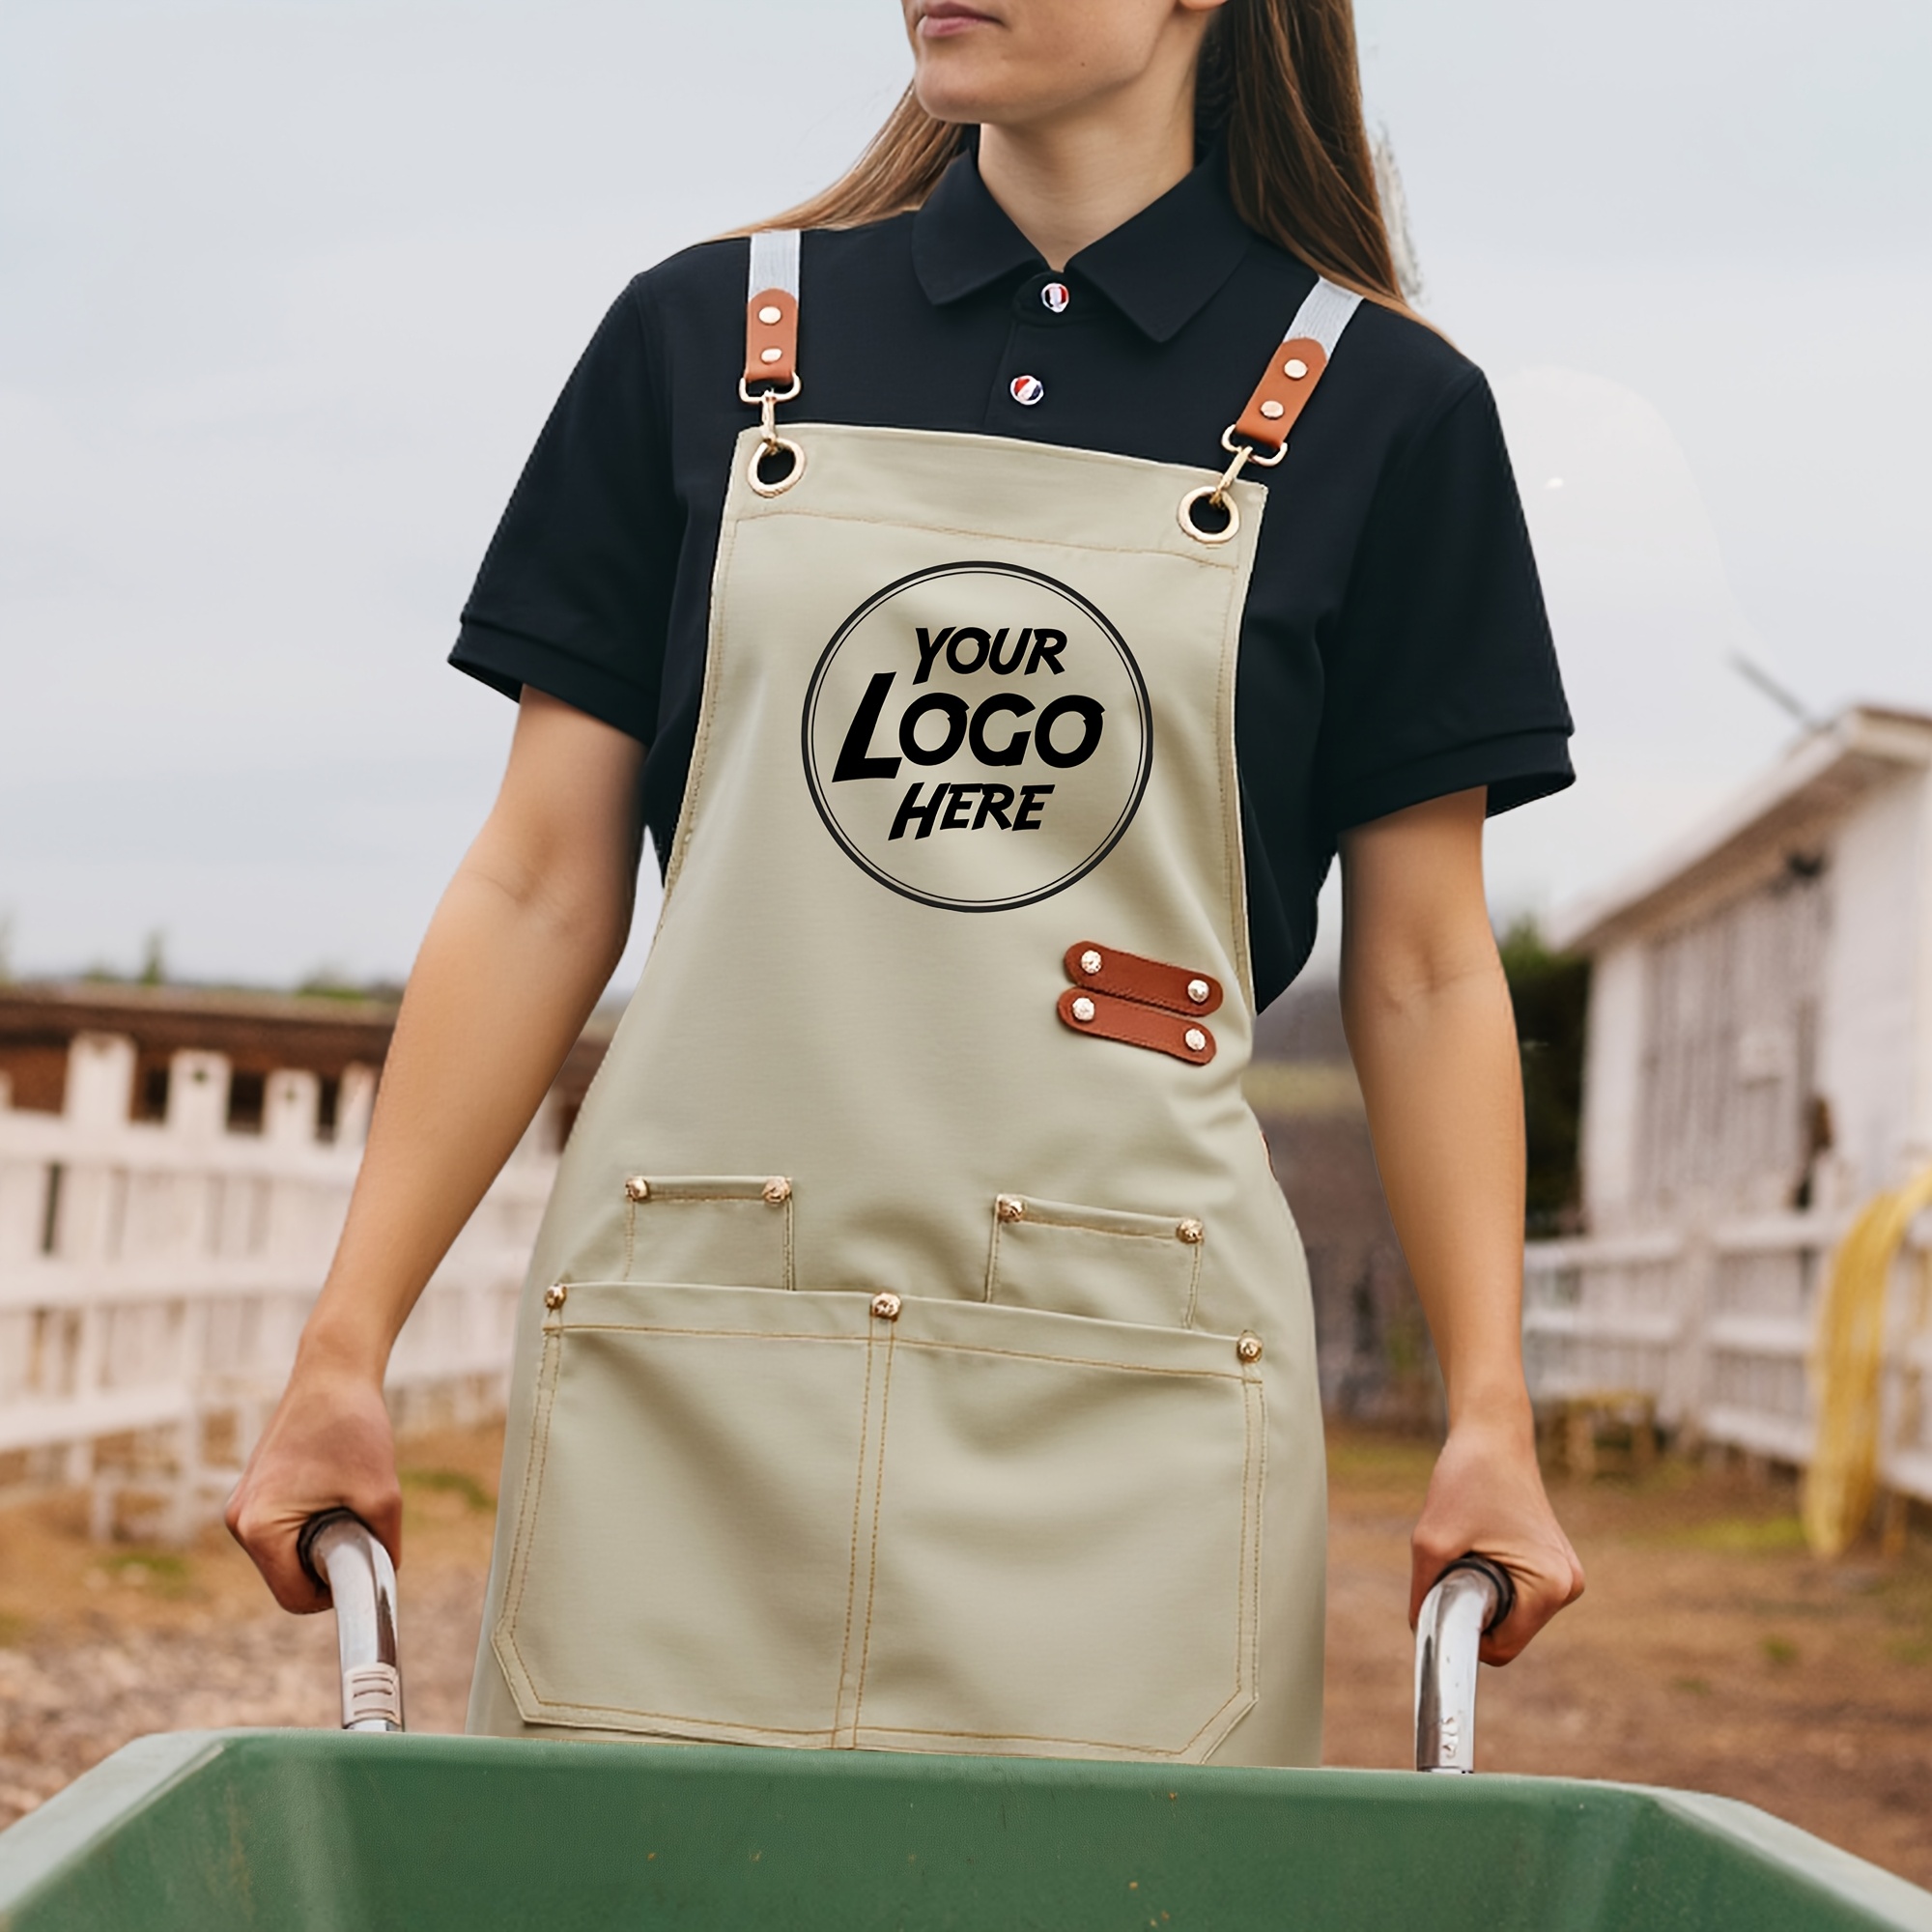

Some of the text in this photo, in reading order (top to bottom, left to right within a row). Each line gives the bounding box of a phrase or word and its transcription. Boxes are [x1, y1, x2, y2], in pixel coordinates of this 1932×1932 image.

[912, 626, 1067, 686] YOUR
[831, 671, 1106, 783] LOGO
[888, 781, 1056, 841] HERE
